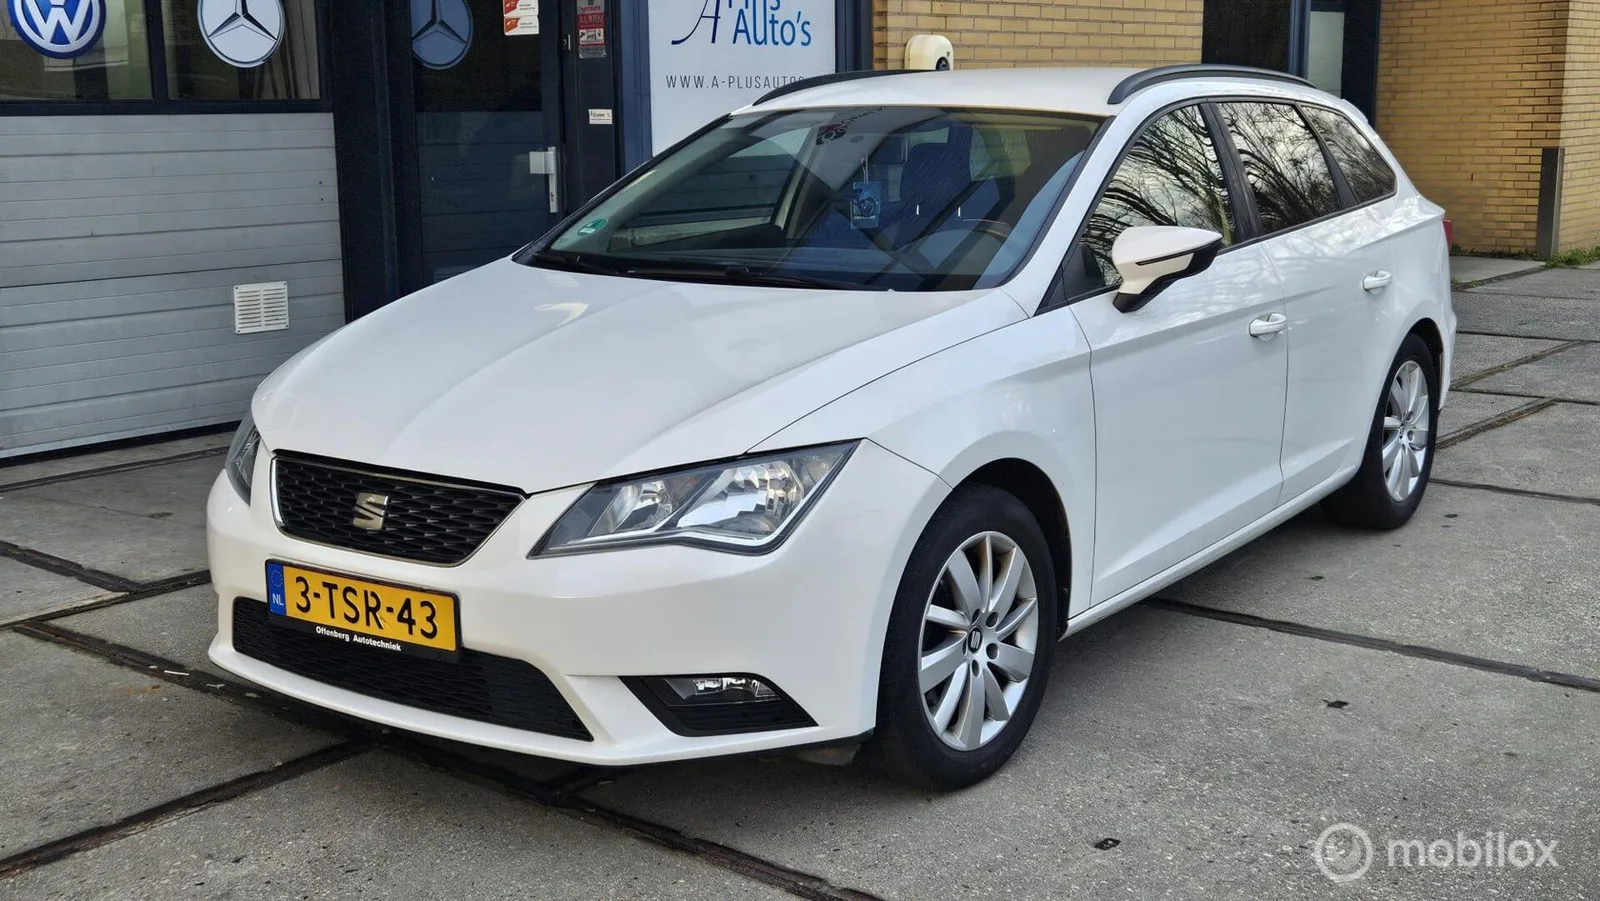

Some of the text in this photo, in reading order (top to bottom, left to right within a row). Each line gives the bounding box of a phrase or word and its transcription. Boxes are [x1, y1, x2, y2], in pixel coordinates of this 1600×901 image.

[579, 15, 604, 25] ALARM
[732, 6, 812, 47] Auto's
[272, 593, 284, 606] NL
[295, 576, 438, 639] 3-TSR-43
[315, 626, 402, 652] Offenberg Autotechniek
